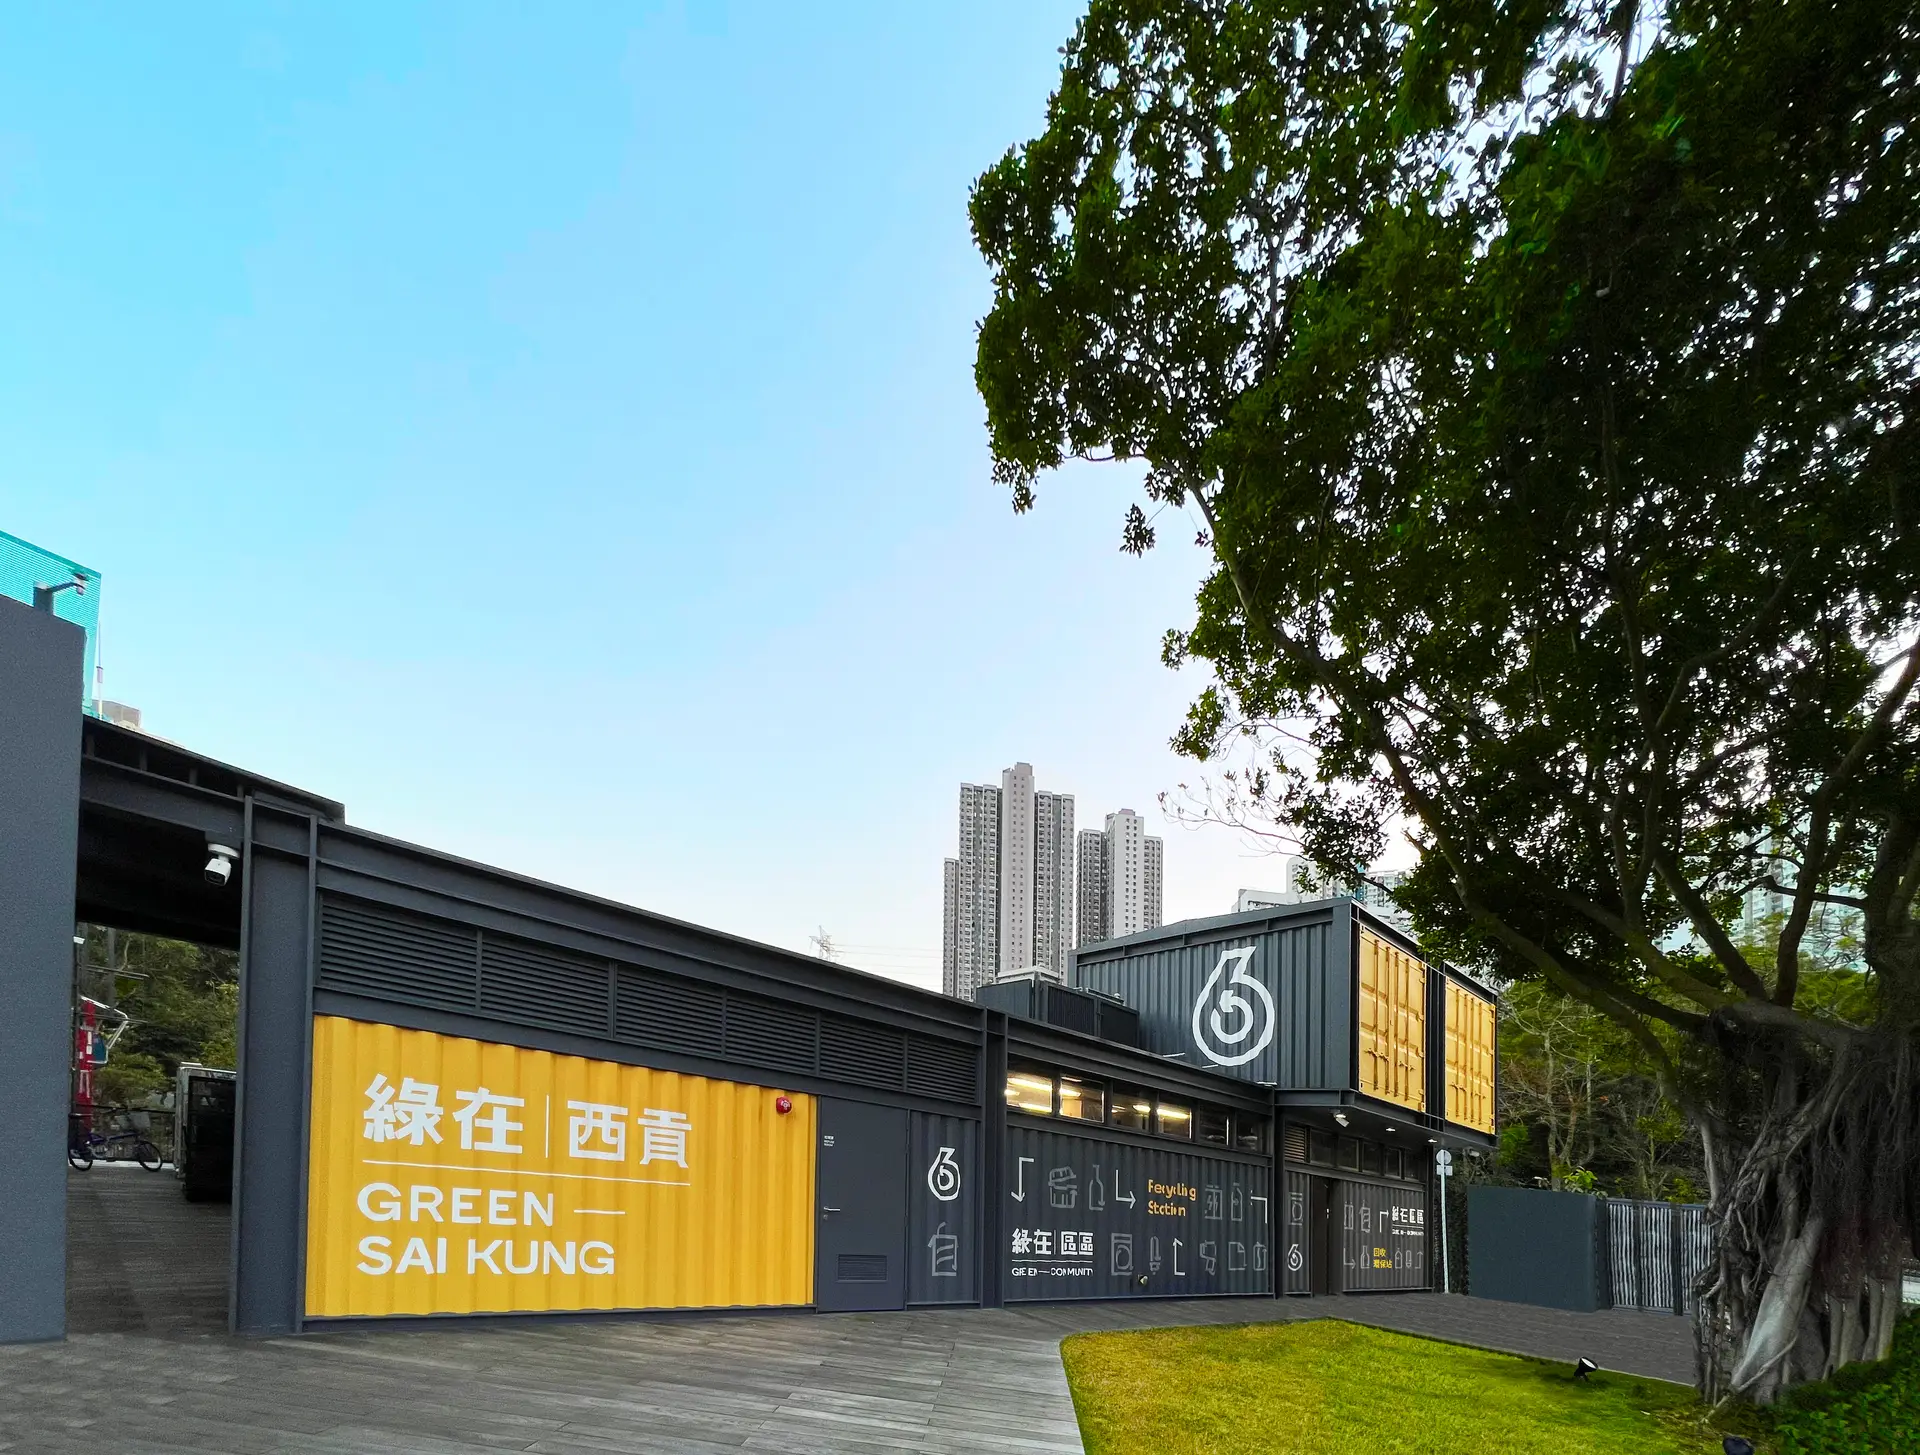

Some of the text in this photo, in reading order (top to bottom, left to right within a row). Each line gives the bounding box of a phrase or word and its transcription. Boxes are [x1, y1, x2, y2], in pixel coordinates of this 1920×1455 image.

[362, 1072, 692, 1169] 綠在 西貢
[357, 1182, 554, 1227] GREEN
[356, 1235, 616, 1275] SAI KUNG
